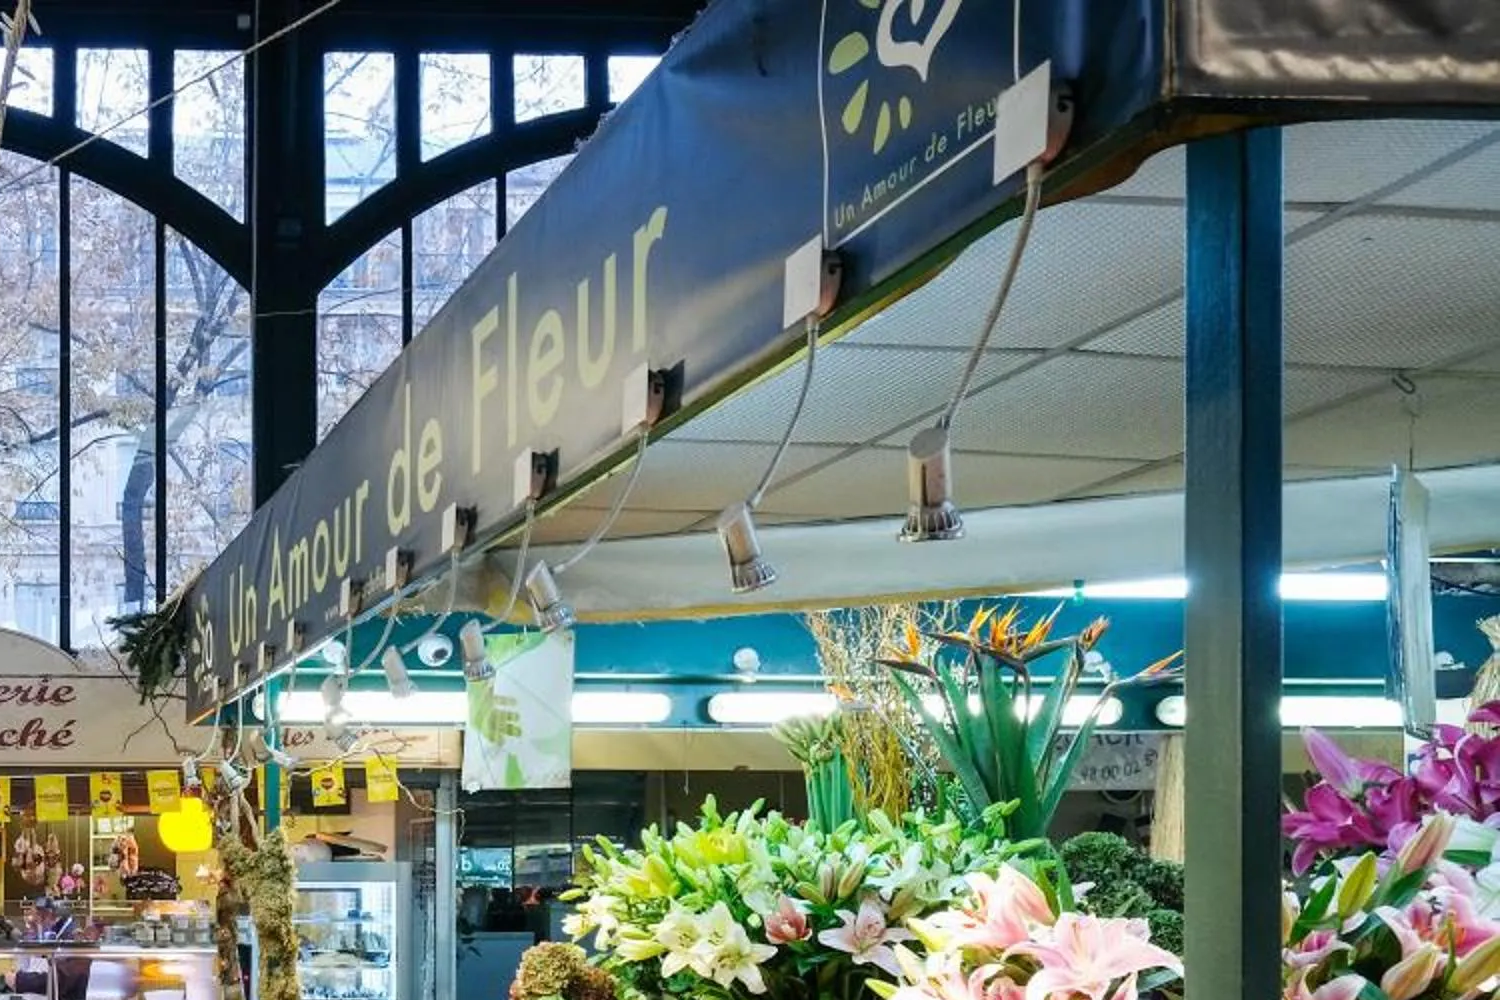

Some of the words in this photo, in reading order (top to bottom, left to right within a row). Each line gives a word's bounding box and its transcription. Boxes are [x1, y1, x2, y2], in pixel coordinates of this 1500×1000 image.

[834, 201, 855, 229] Un
[861, 154, 917, 210] Amour
[925, 132, 948, 163] de
[957, 97, 998, 141] Fleu
[228, 564, 257, 657] Un
[267, 479, 369, 630] Amour
[387, 382, 443, 537] de
[471, 204, 669, 474] Fleur
